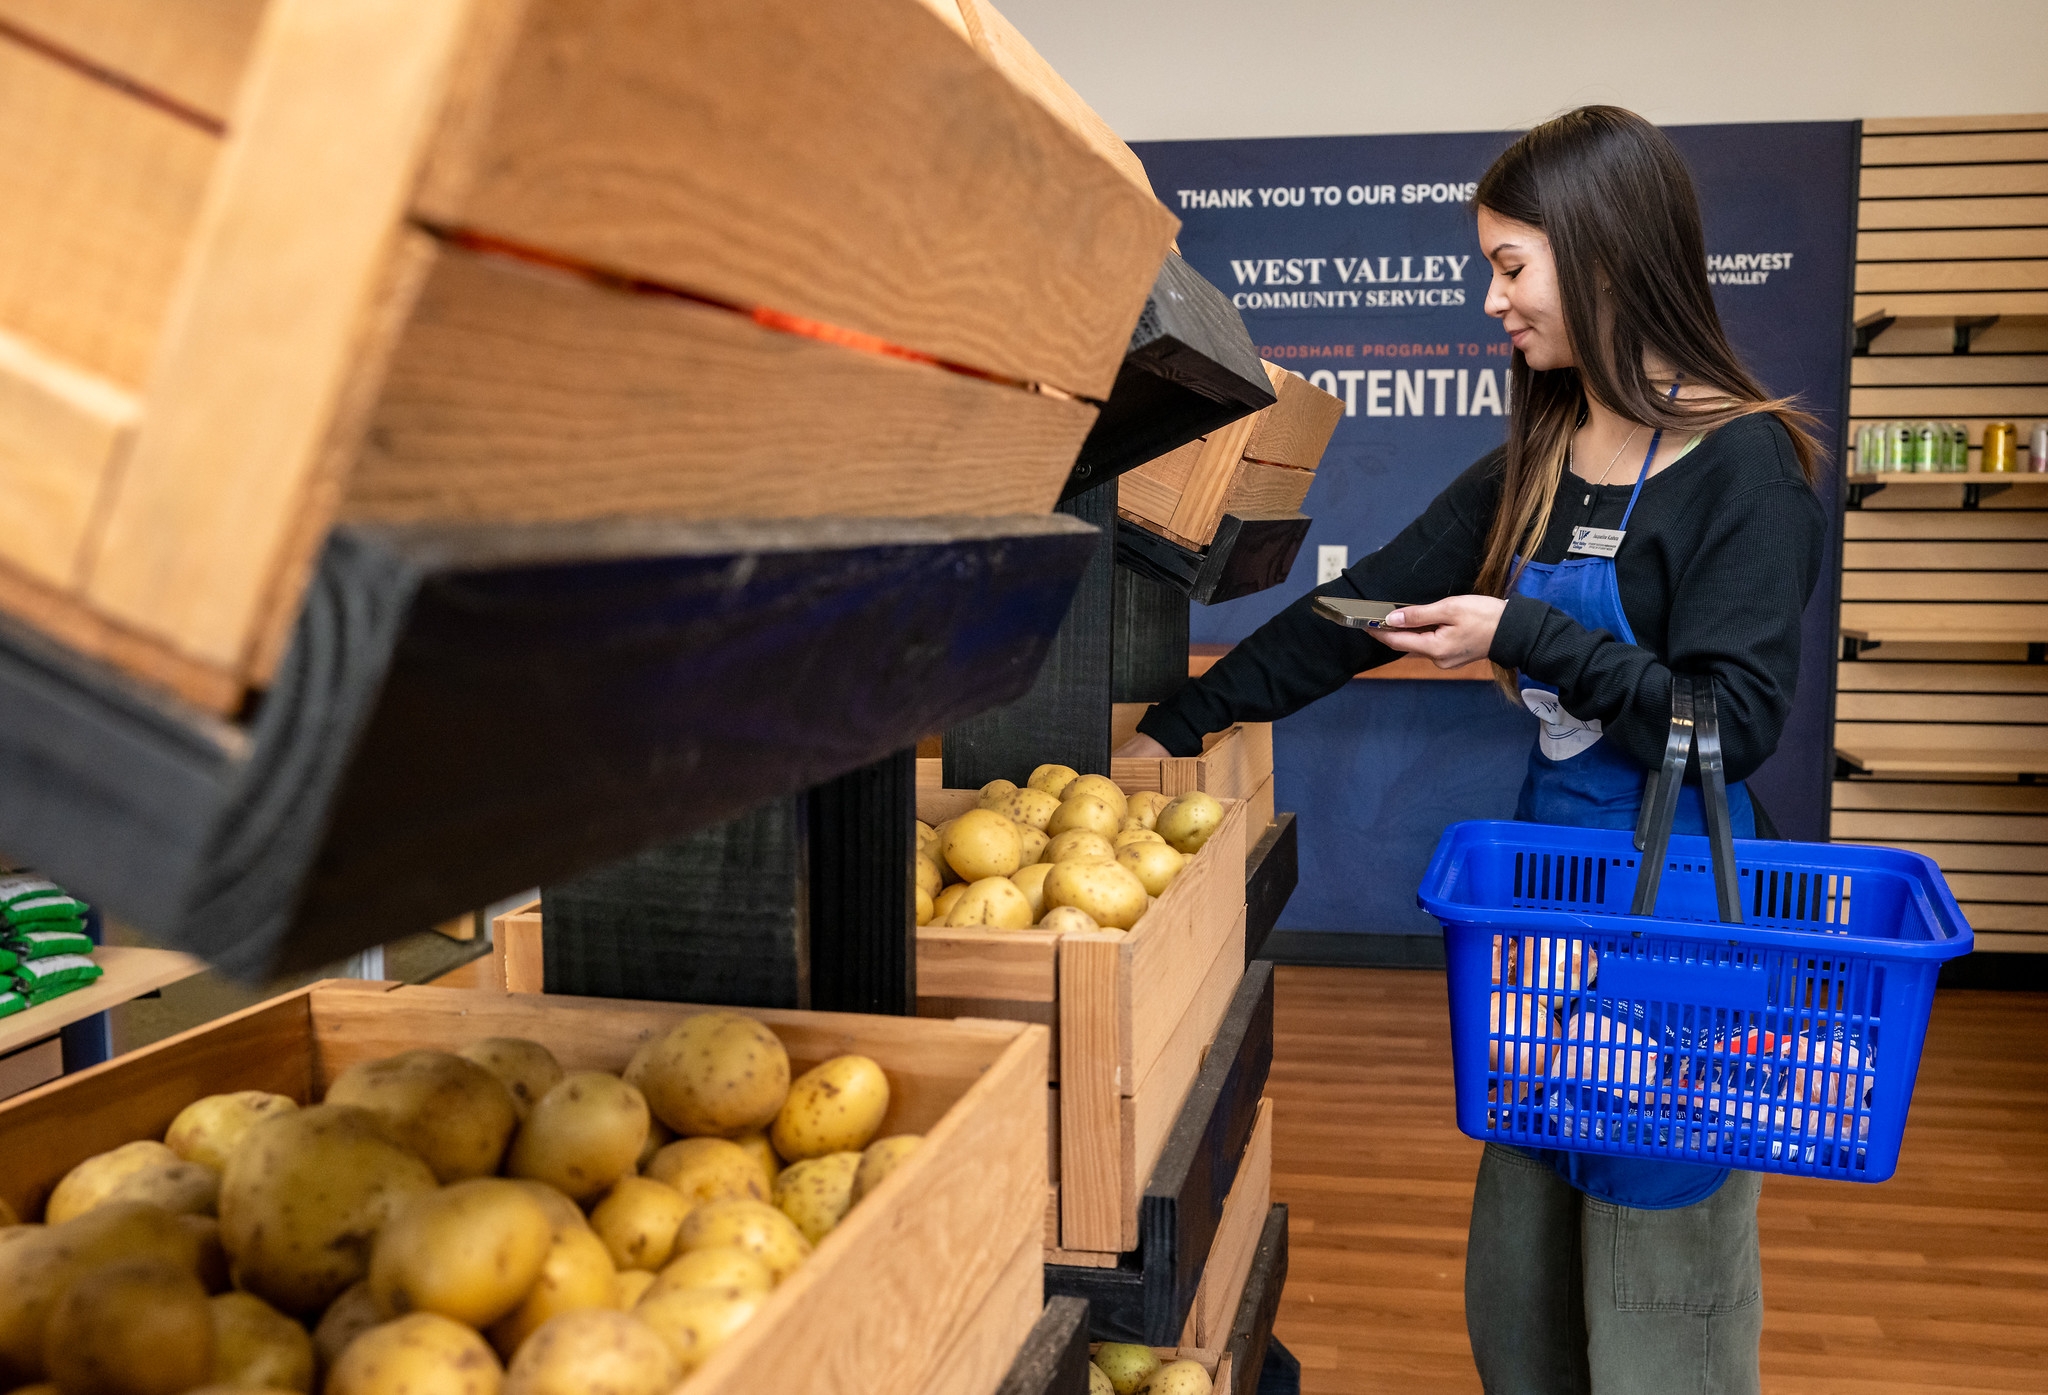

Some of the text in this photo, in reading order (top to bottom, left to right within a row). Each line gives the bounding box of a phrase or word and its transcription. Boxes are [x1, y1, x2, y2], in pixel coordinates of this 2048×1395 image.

[1177, 181, 1478, 209] THANK YOU TO OUR SPONS
[1230, 255, 1471, 286] WEST VALLEY
[1707, 252, 1794, 271] HARVEST
[1718, 271, 1769, 285] VALLEY
[1232, 288, 1466, 310] COMMUNITY SERVICES
[1362, 343, 1450, 358] PROGRAM
[1457, 342, 1480, 356] TO
[1486, 342, 1513, 356] HE
[1289, 368, 1513, 417] OTENTIA
